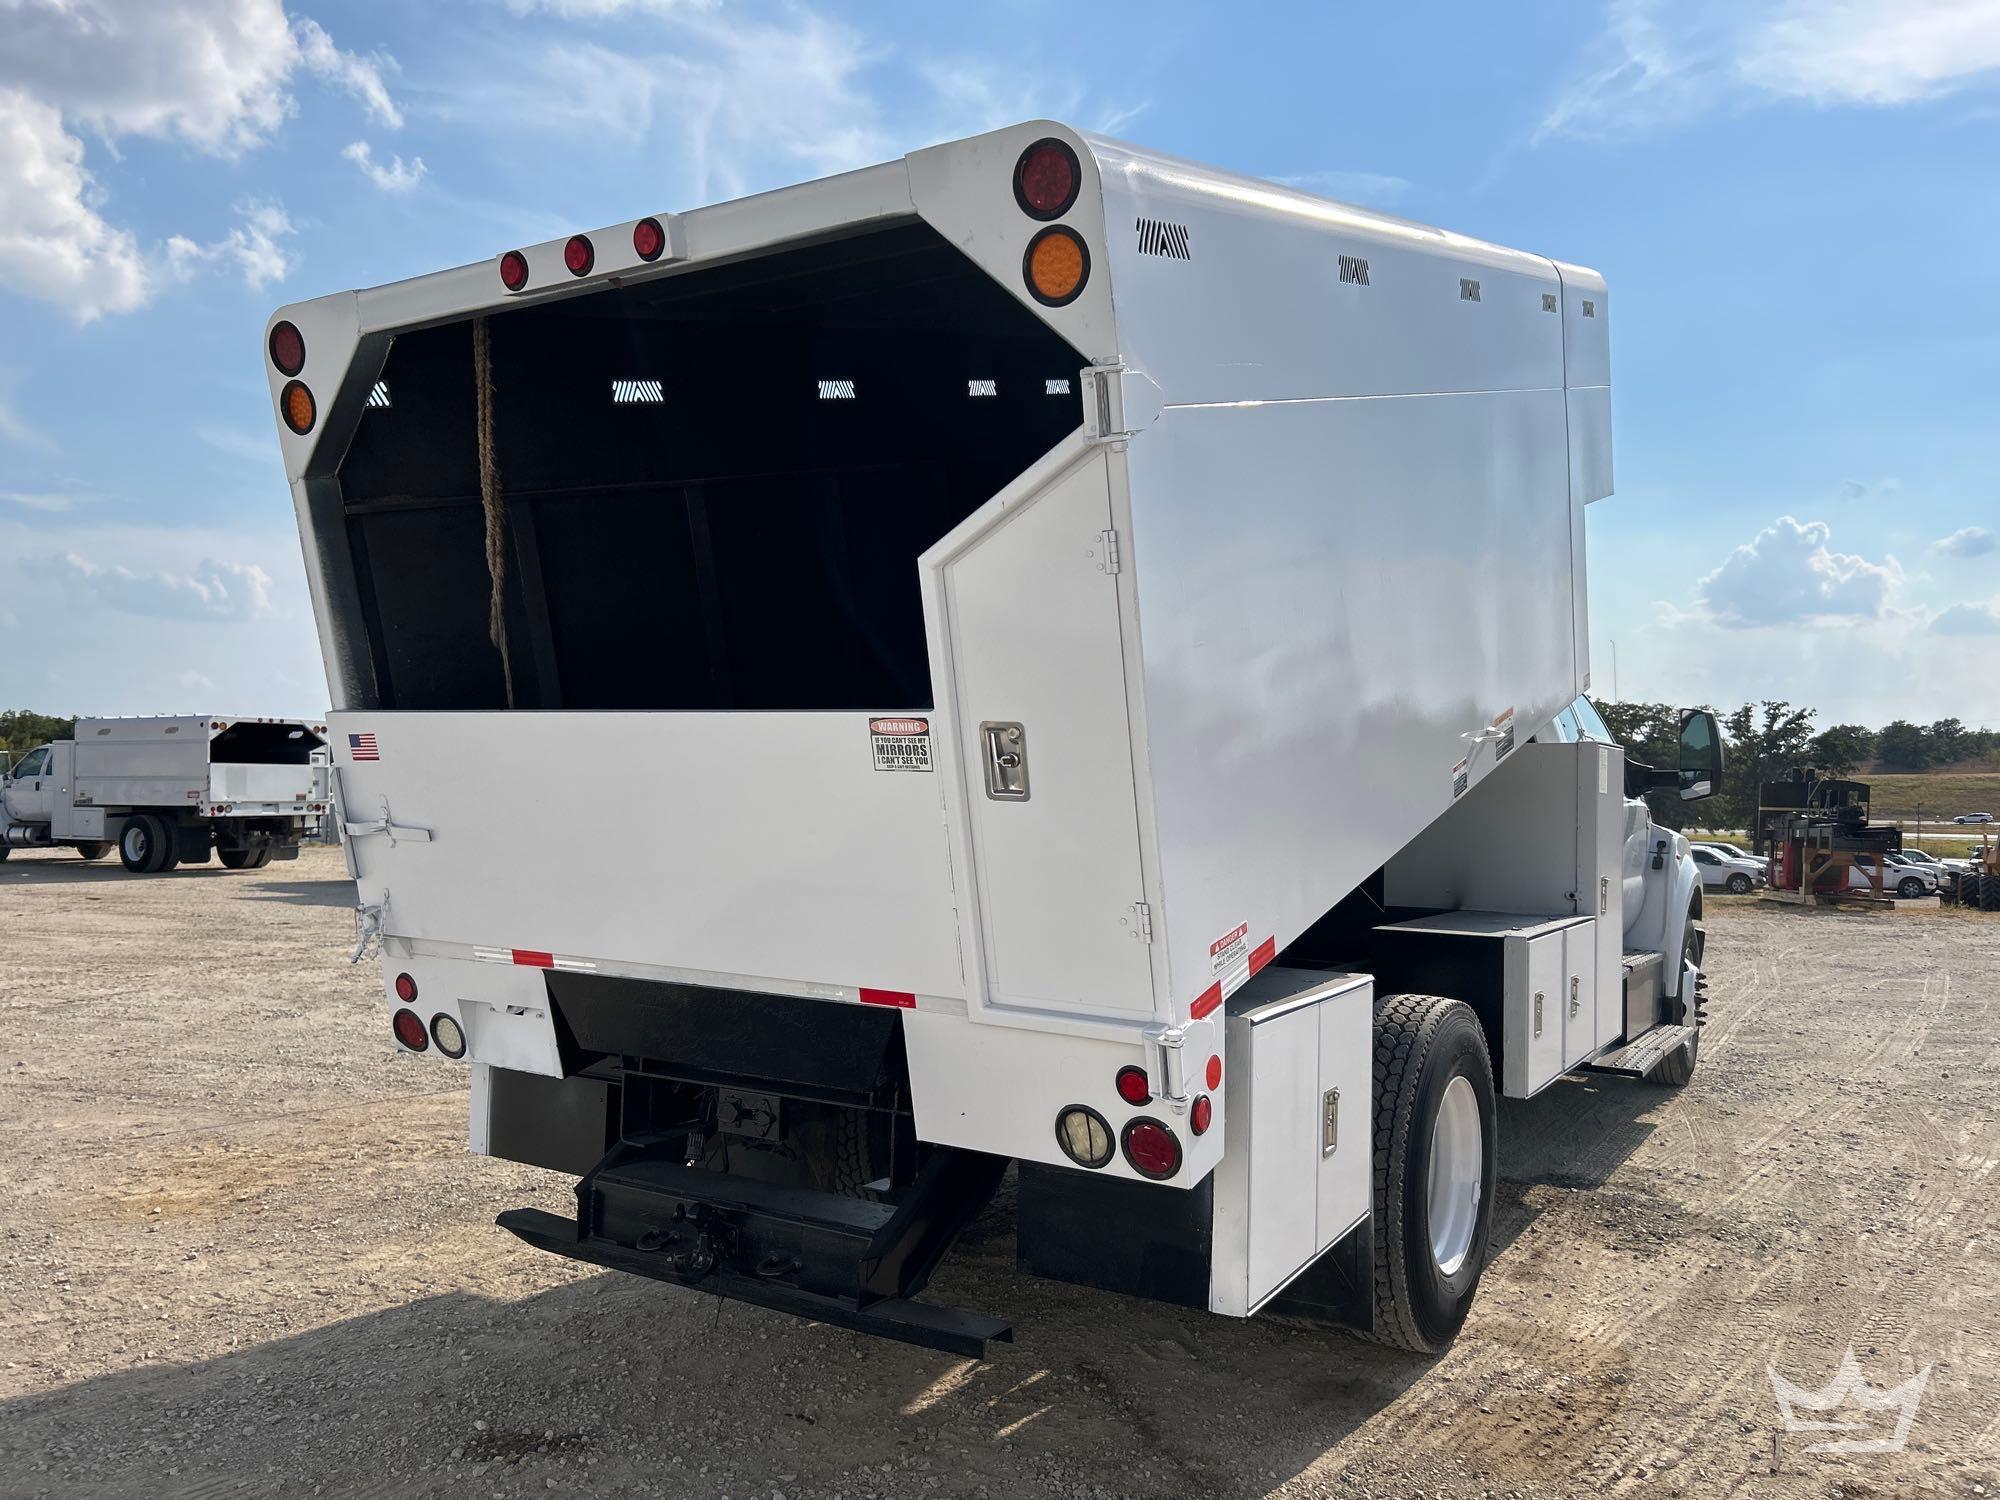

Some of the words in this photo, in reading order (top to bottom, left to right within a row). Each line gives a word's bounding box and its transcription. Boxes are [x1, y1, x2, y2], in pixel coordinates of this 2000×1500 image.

[879, 722, 920, 732] WARNING
[876, 744, 927, 756] MIRRORS
[882, 756, 900, 764] CAN'T
[901, 757, 913, 765] SEE
[915, 757, 928, 765] YOU
[1218, 931, 1239, 949] DANGER
[1216, 948, 1229, 960] STAND
[1230, 938, 1242, 952] CLEAR
[1226, 942, 1247, 962] OPERATING
